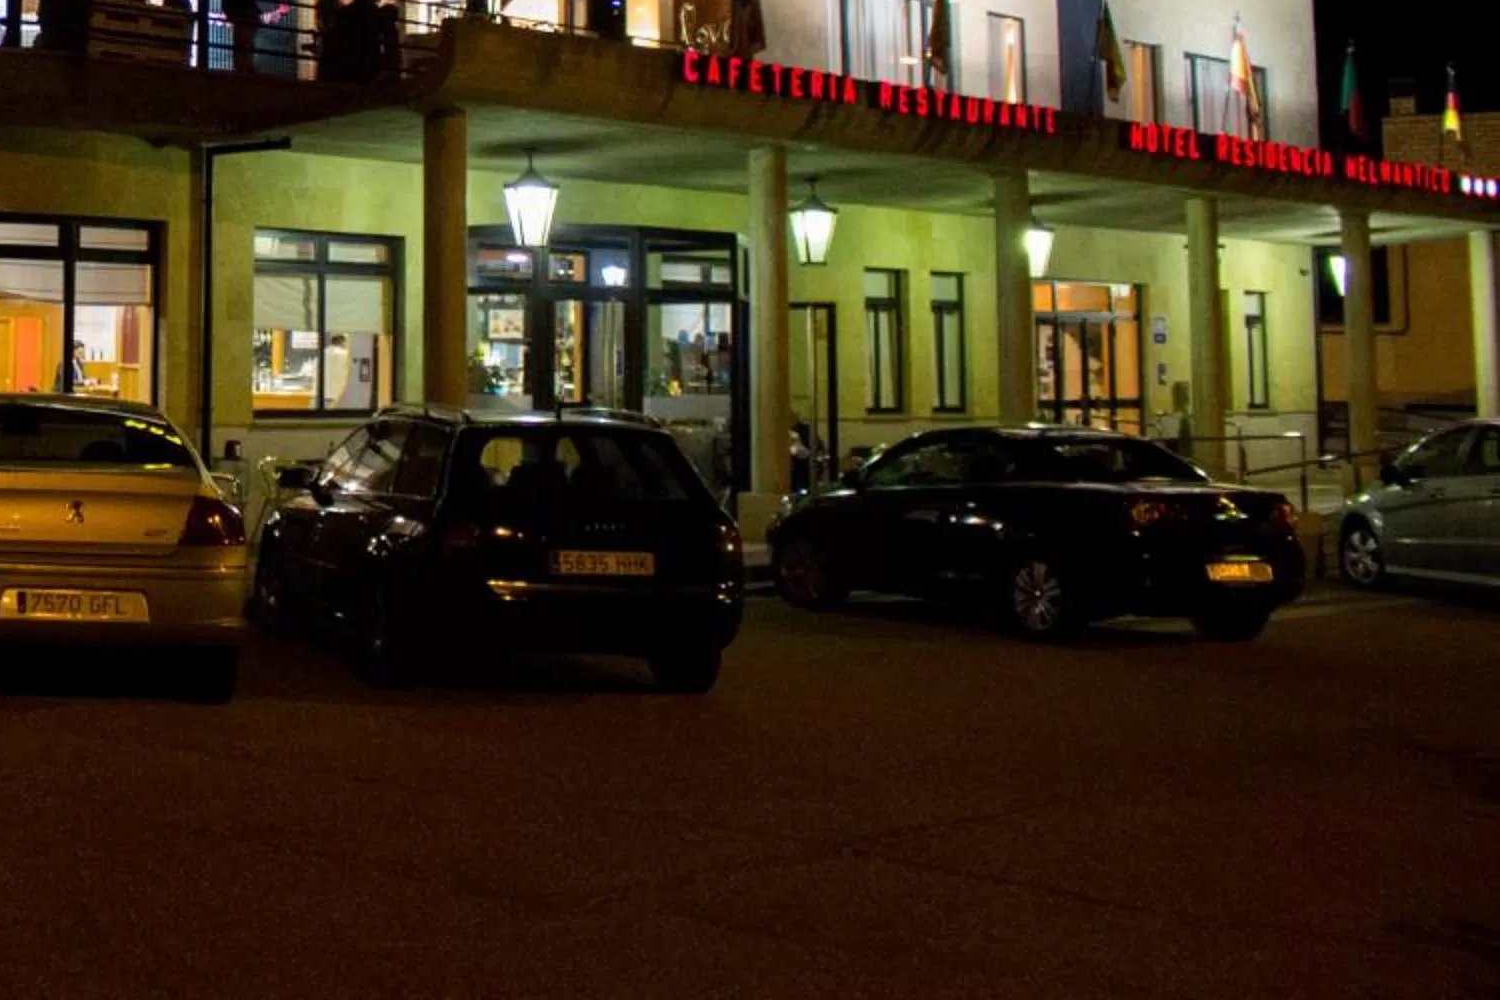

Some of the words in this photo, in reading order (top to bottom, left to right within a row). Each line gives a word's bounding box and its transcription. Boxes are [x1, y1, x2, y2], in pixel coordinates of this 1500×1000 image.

[683, 51, 856, 104] CAFETERIA
[878, 80, 1055, 134] RESTAURANTE
[1129, 121, 1200, 160] HOTEL
[1216, 132, 1333, 176] RESIDENCIA
[1345, 154, 1450, 193] HELMANTICO
[31, 593, 82, 613] 7570
